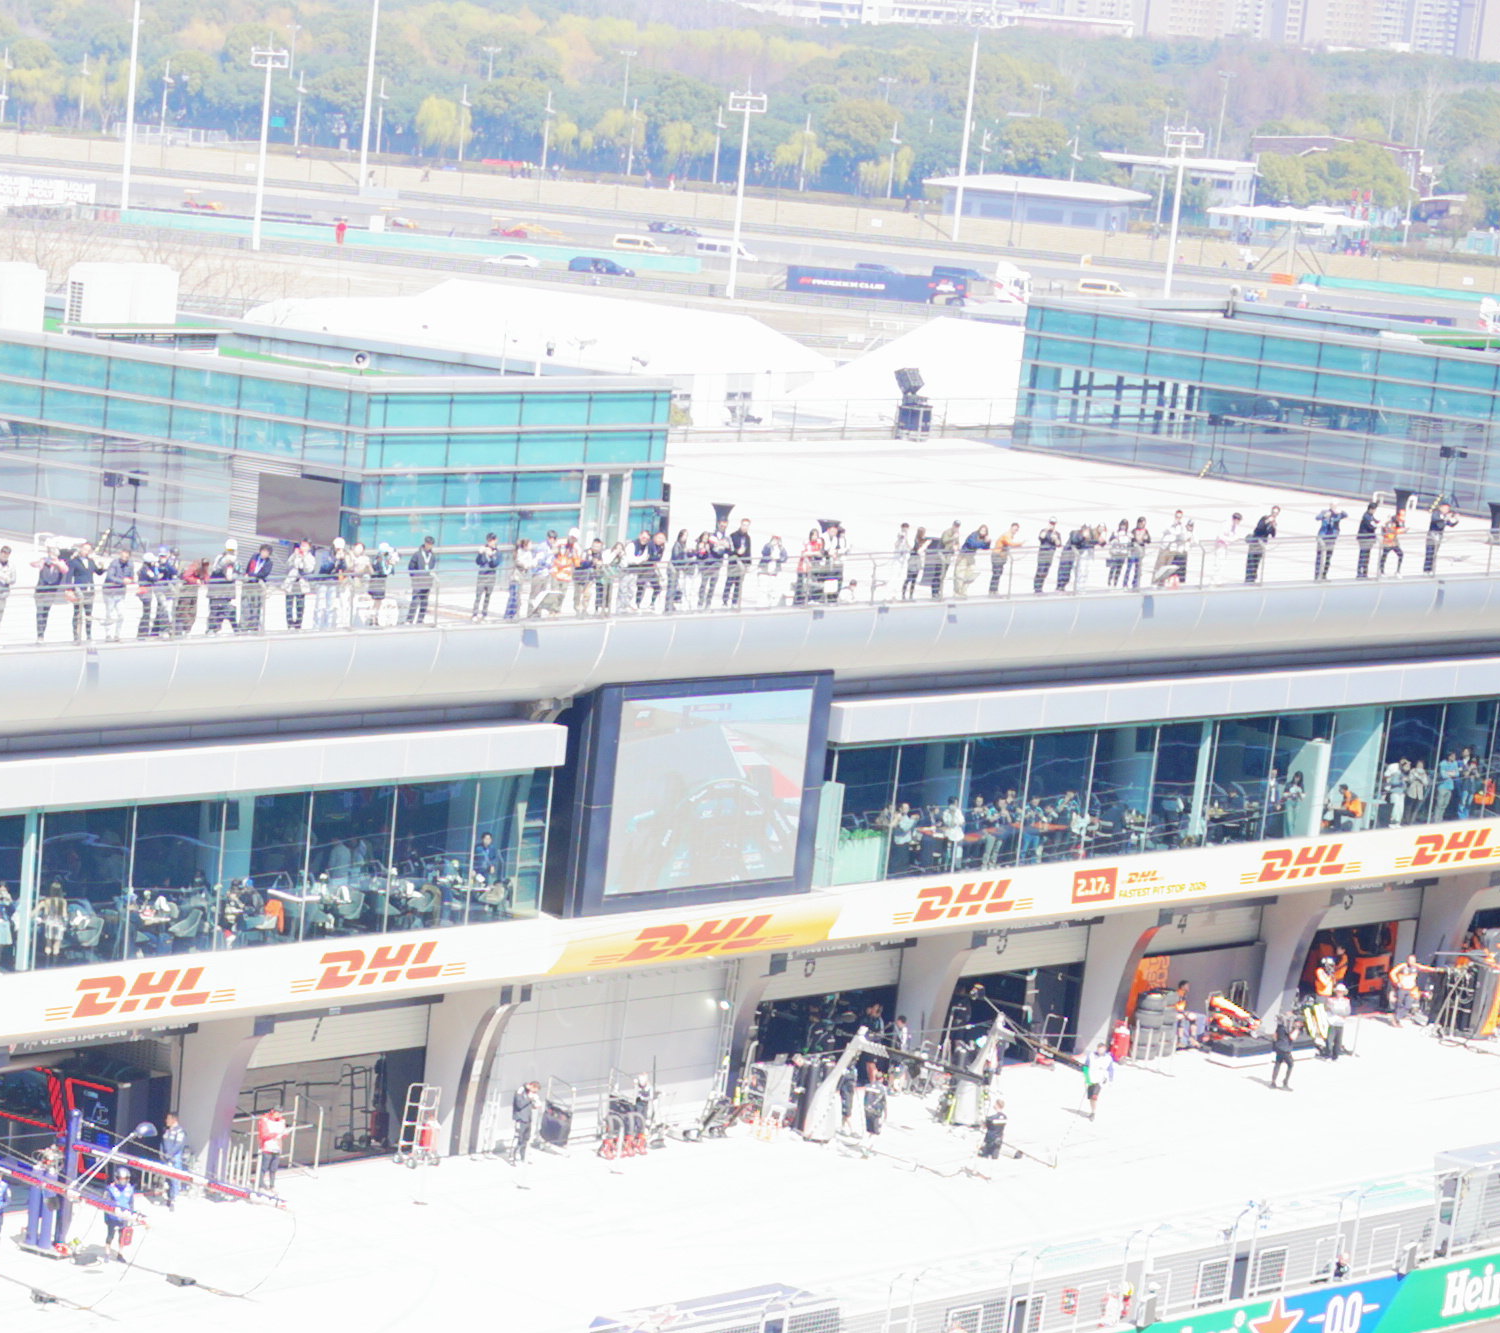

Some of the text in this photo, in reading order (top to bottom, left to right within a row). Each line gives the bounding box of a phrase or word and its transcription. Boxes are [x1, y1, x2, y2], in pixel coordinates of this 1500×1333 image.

[1258, 844, 1345, 882] DHL
[1412, 829, 1494, 866] DHL
[1119, 889, 1150, 898] FASTEST
[1153, 887, 1166, 896] PIT
[1167, 885, 1186, 894] STOP
[1127, 871, 1158, 883] DHL
[913, 879, 1016, 923] DHL
[621, 914, 774, 962] DHL
[314, 942, 444, 991] DHL
[73, 967, 209, 1018] DHL
